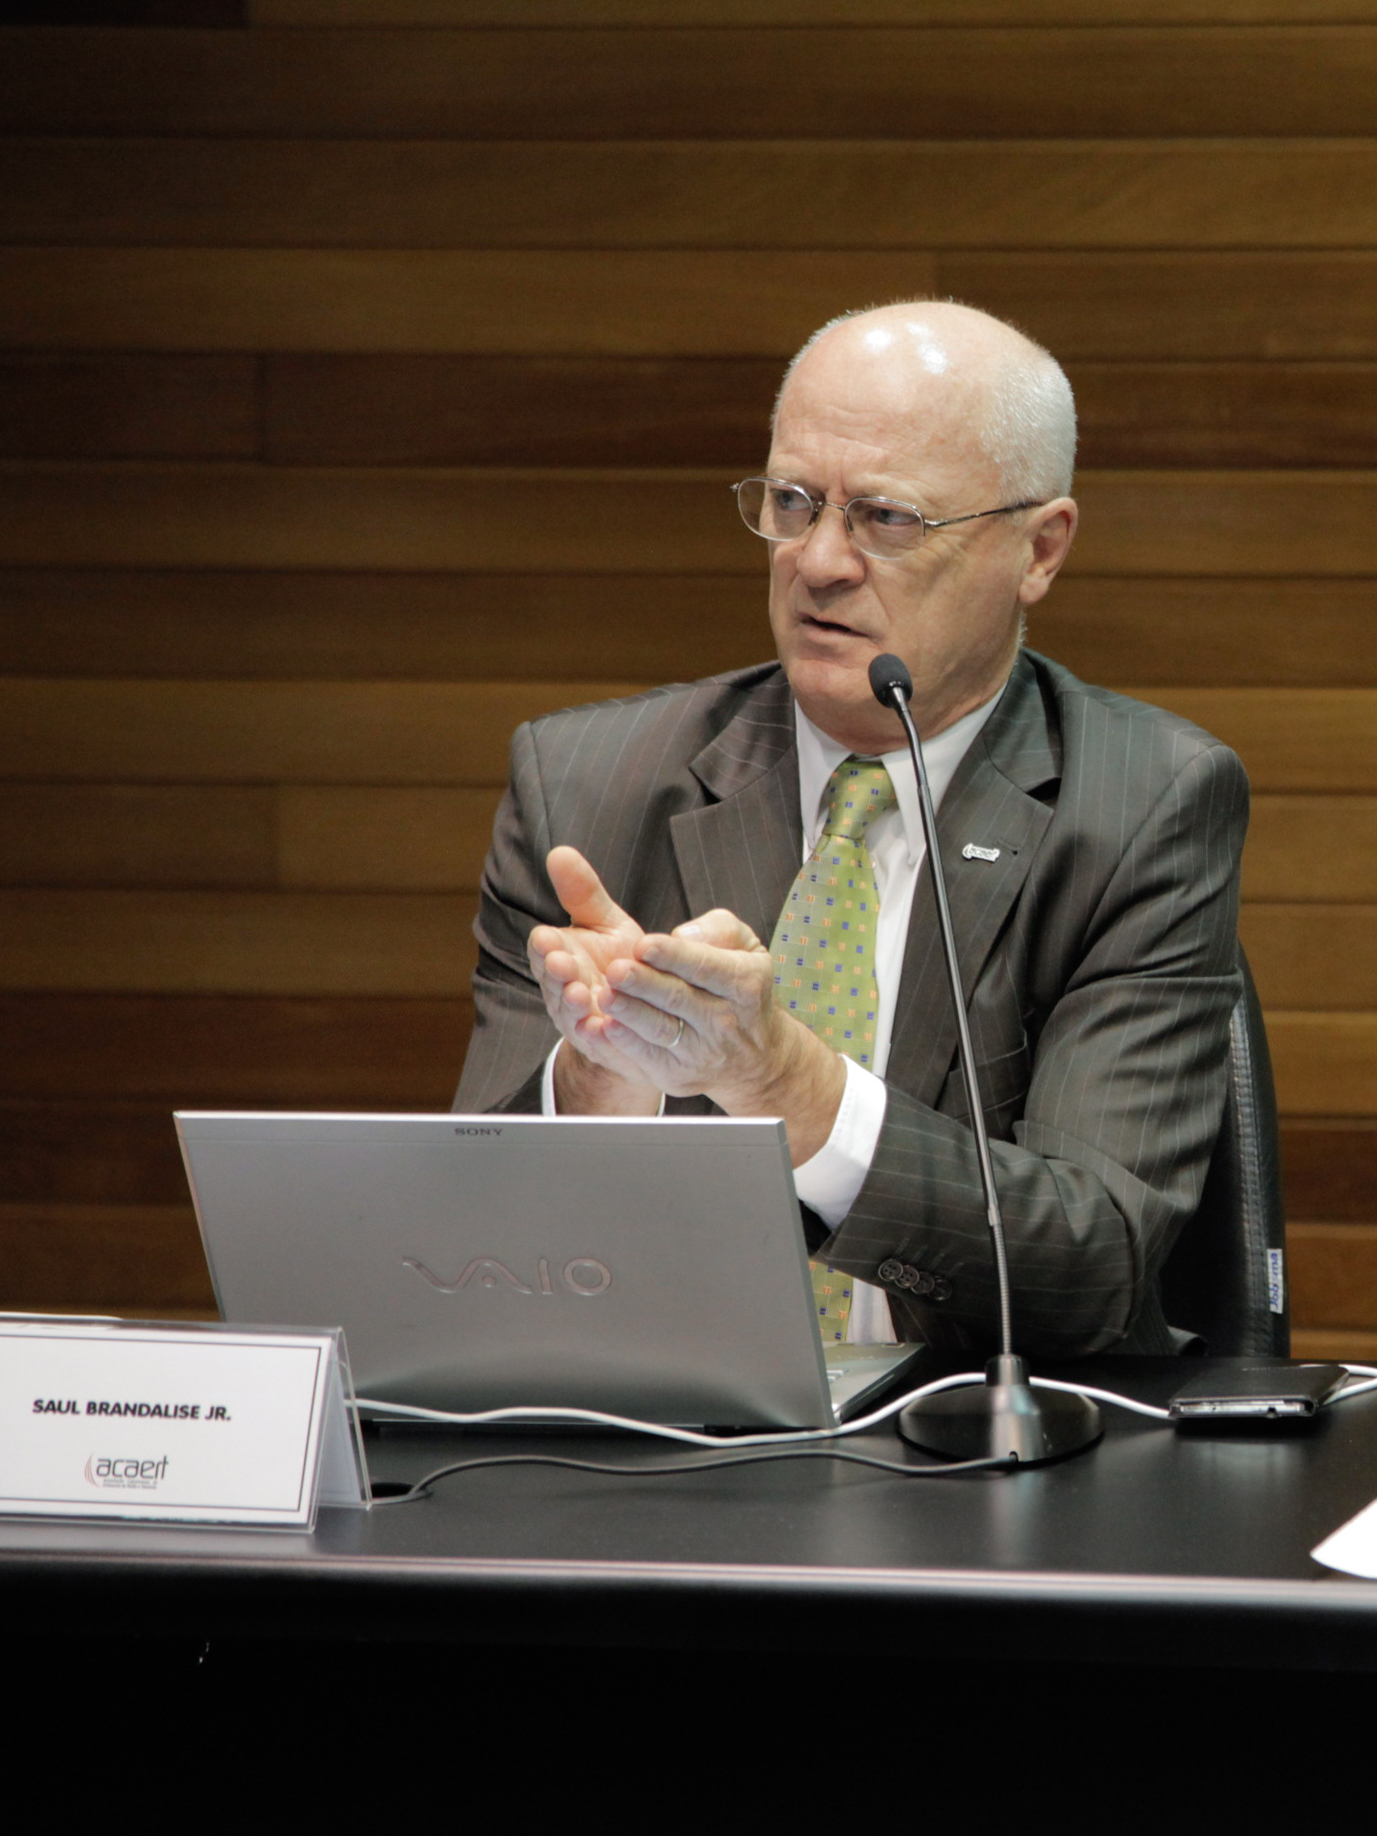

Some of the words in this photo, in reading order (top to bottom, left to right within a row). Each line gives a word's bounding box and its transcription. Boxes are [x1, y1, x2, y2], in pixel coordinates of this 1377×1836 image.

[454, 1127, 503, 1137] SONY
[401, 1256, 613, 1297] VAIO
[32, 1399, 80, 1415] SAUL
[86, 1401, 201, 1420] BRANDALISE
[204, 1405, 232, 1422] JR.
[96, 1454, 170, 1480] acaert
